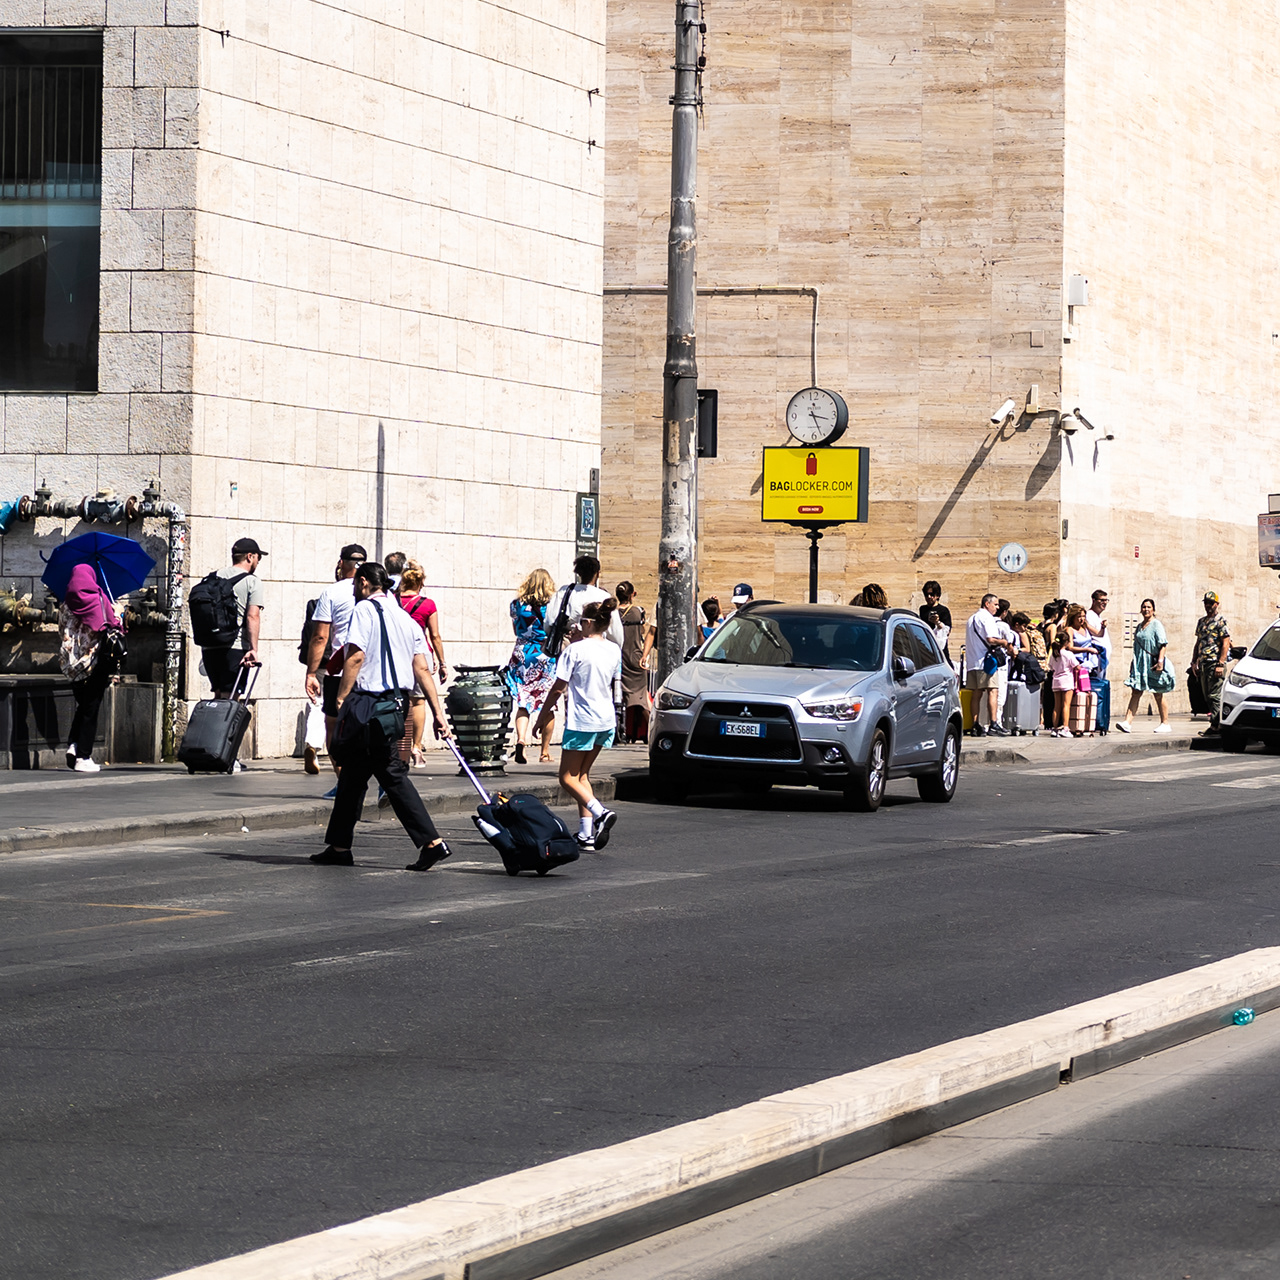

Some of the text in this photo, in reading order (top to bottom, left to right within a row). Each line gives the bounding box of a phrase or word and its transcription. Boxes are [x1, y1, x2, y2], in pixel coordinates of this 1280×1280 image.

[808, 391, 819, 401] 12
[791, 413, 797, 421] 9
[811, 432, 817, 440] 6
[770, 481, 853, 491] BAGLOCKER.COM
